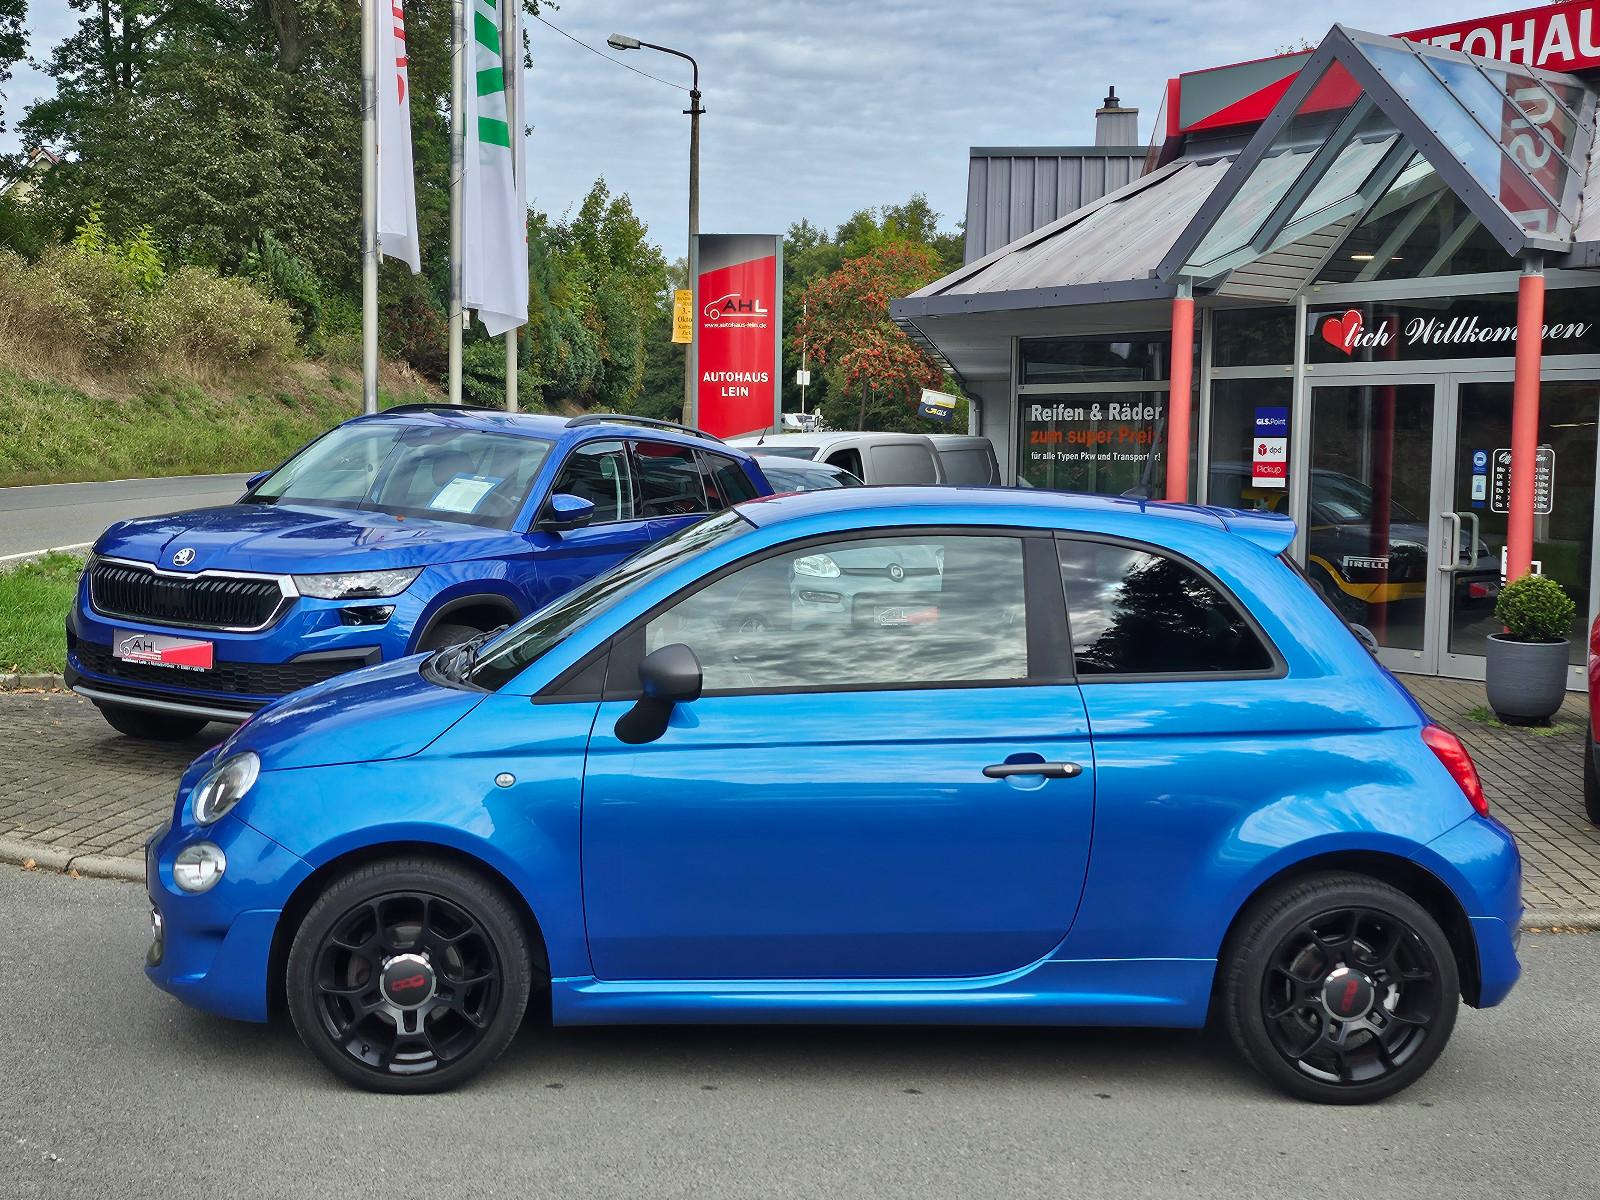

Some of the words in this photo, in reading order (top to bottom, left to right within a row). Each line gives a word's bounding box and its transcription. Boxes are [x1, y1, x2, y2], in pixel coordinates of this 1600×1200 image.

[723, 299, 768, 312] AHL
[1343, 320, 1396, 348] lich
[703, 371, 769, 383] AUTOHAUS
[721, 386, 749, 397] LEIN
[1031, 403, 1084, 421] Reifen
[1089, 403, 1103, 421] &
[1108, 402, 1163, 421] Räder
[1030, 430, 1063, 444] zum
[1068, 430, 1113, 447] super
[1268, 446, 1282, 455] dpd
[1031, 451, 1041, 460] für
[1042, 451, 1056, 460] alle
[1057, 451, 1079, 462] Typen
[1080, 451, 1096, 461] Pkw
[1097, 452, 1111, 461] und
[1112, 452, 1162, 463] Transportr!
[1256, 464, 1282, 475] Pickup
[132, 639, 162, 653] AHL
